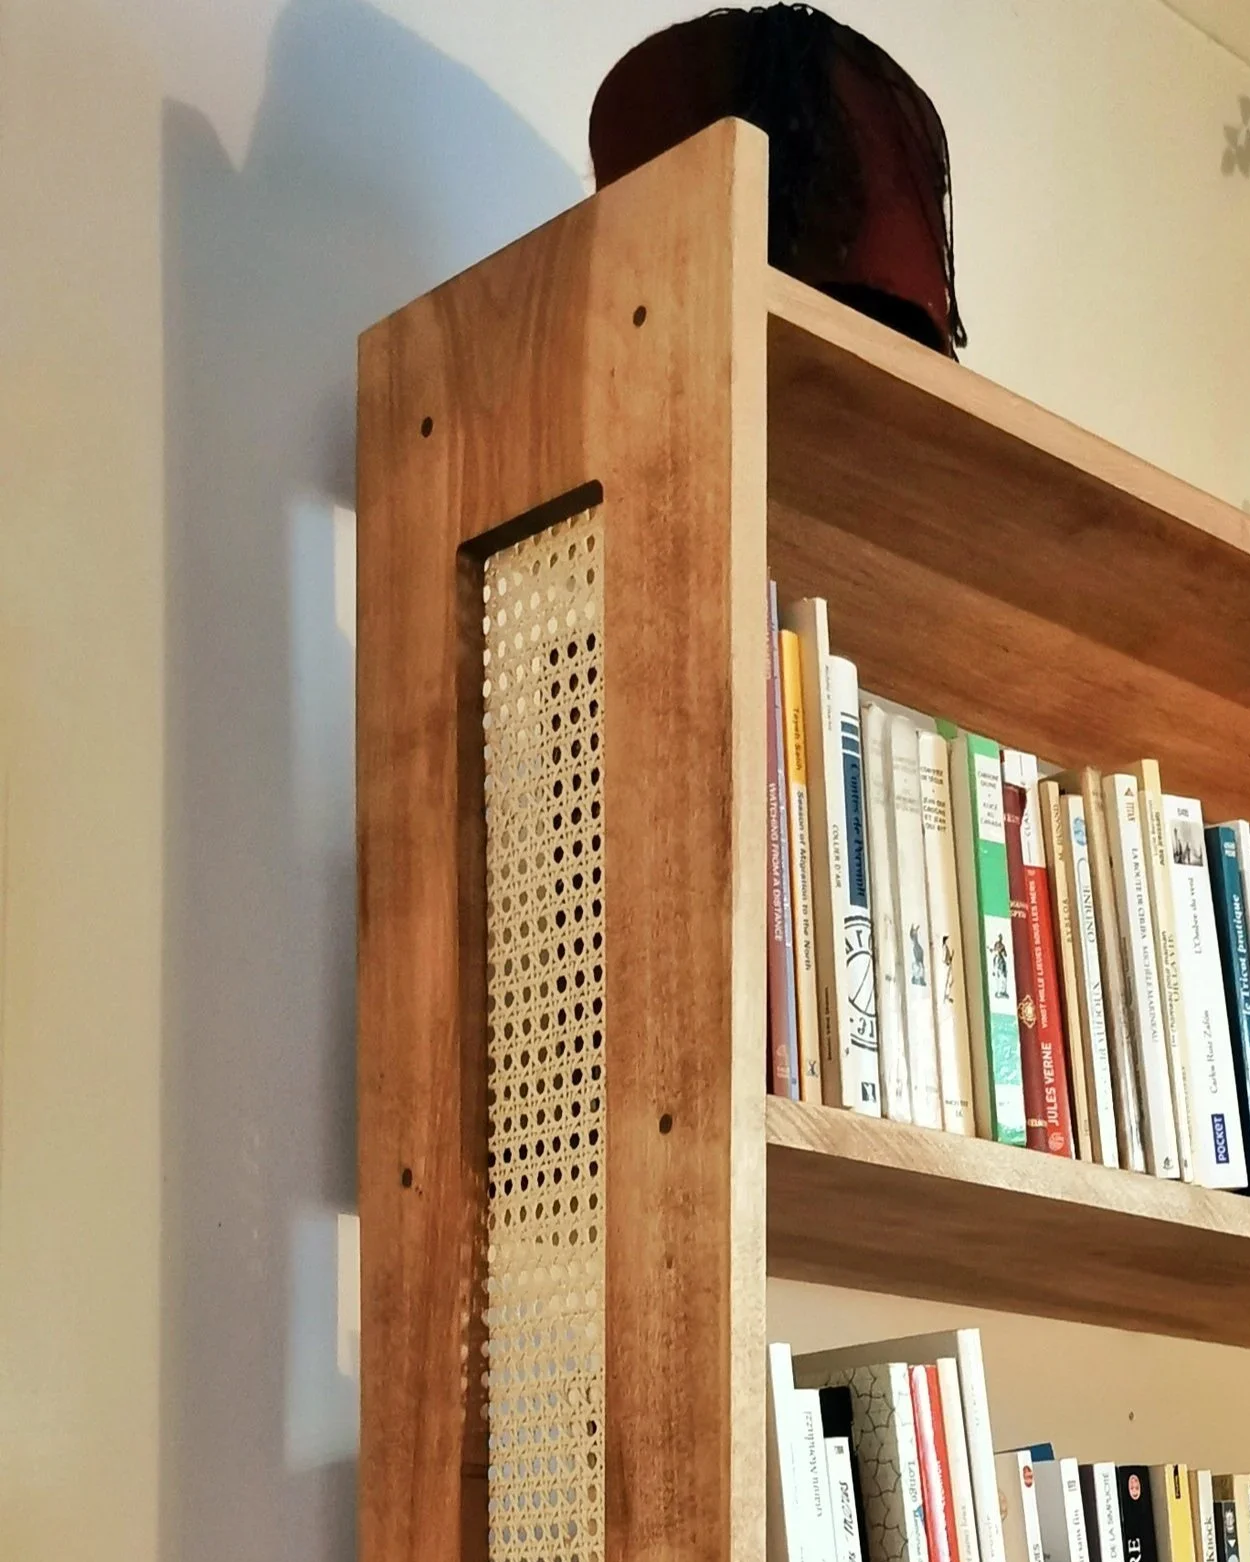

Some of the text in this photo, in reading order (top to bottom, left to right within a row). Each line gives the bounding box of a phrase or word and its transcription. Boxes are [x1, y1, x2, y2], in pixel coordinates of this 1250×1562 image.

[796, 791, 804, 829] Season
[799, 834, 806, 846] of
[799, 848, 809, 898] Migration
[773, 889, 783, 942] DISTANCE
[802, 900, 808, 915] to
[1232, 893, 1247, 954] pratique
[1237, 956, 1250, 999] Tricot
[1040, 1043, 1059, 1126] JULES VERNE
[1213, 1115, 1227, 1162] POCKET
[1107, 1527, 1116, 1541] LA
[1109, 1544, 1118, 1559] DE
[1204, 1516, 1215, 1562] Knock
